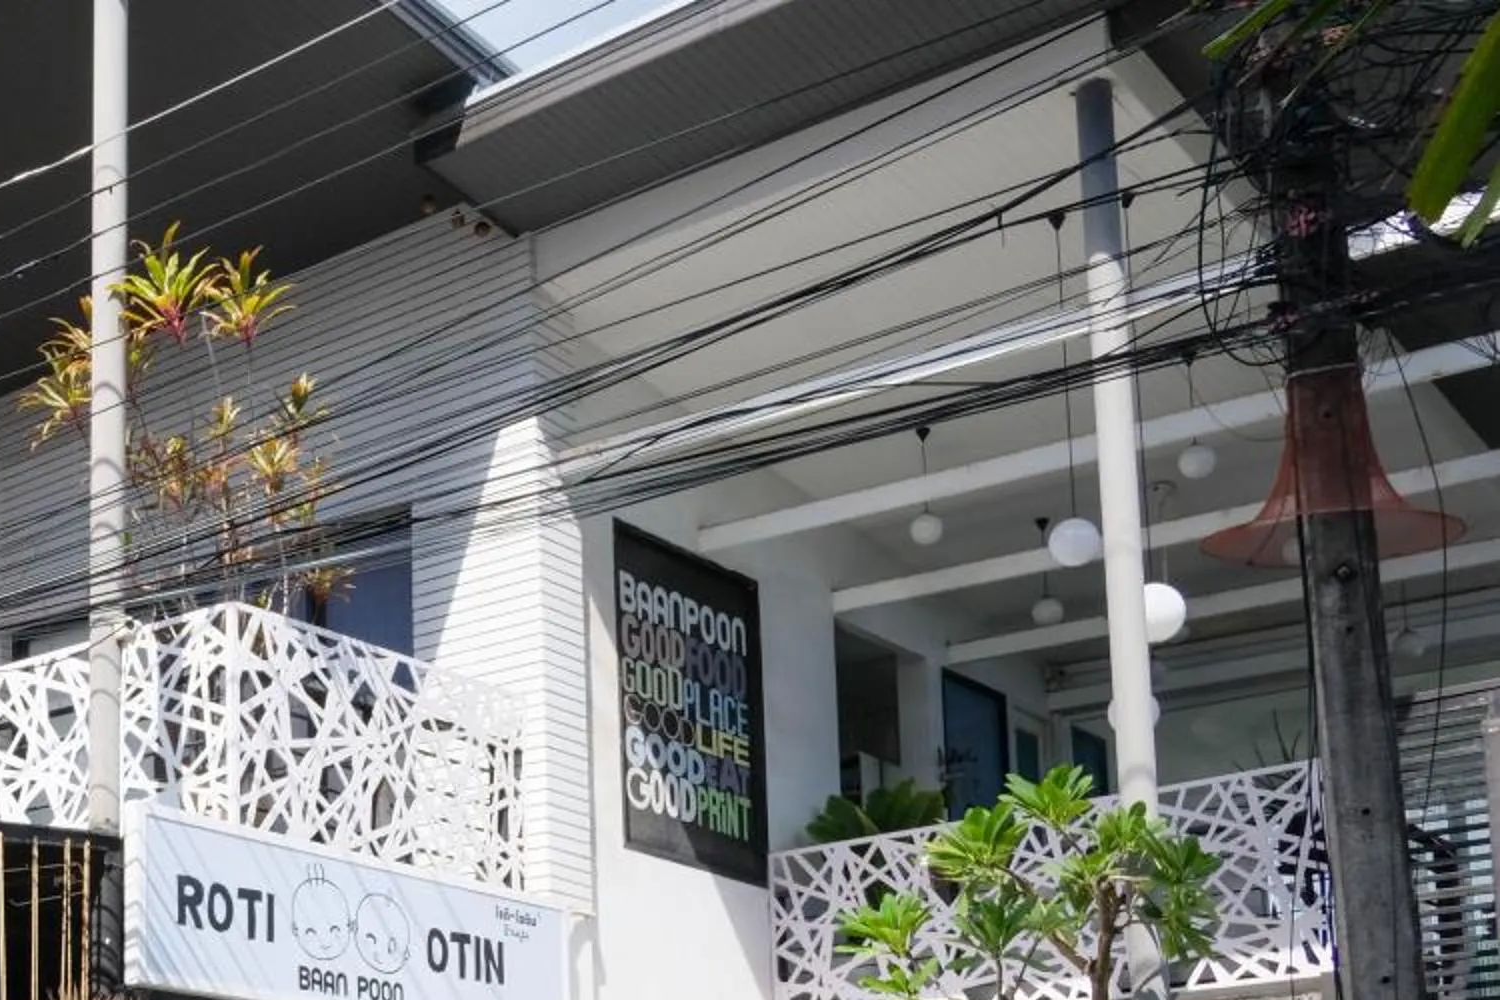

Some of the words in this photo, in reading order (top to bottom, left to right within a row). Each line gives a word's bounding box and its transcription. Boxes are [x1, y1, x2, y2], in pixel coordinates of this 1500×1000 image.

[177, 875, 275, 943] ROTI
[427, 928, 505, 985] OTIN
[299, 965, 349, 997] BAAN
